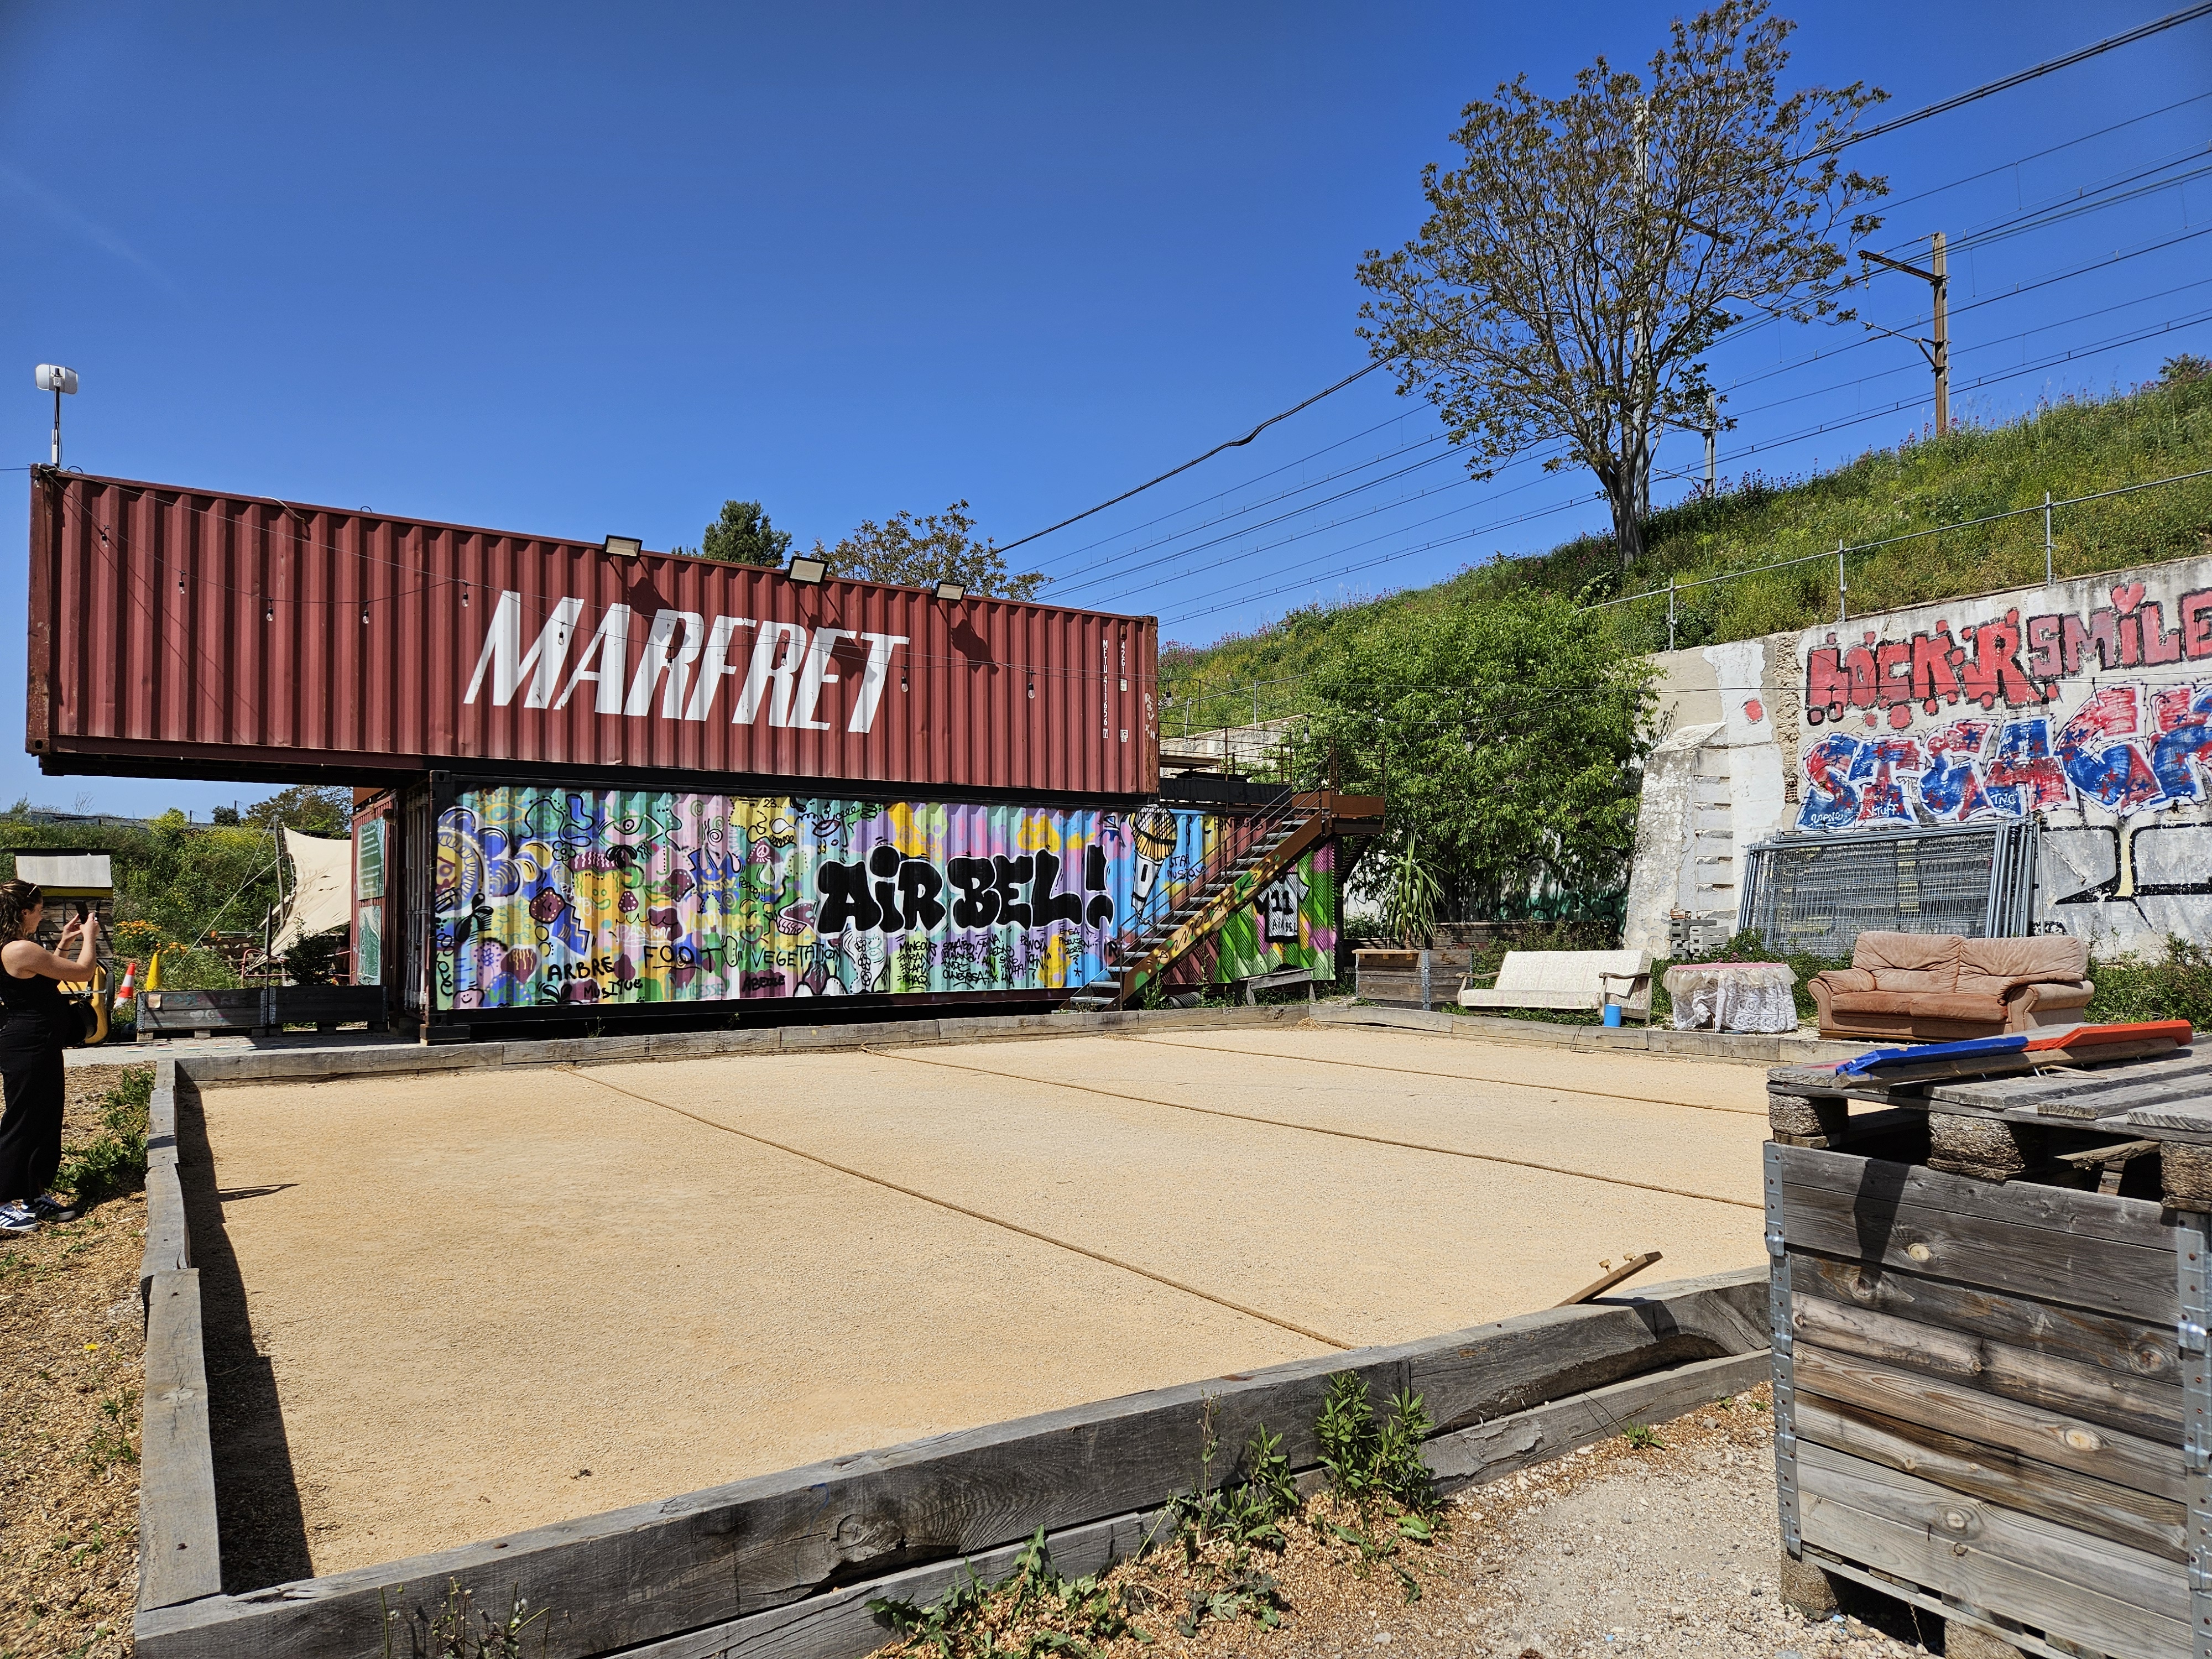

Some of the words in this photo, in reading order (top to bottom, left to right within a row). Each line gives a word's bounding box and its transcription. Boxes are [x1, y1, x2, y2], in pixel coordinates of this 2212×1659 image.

[464, 590, 910, 734] MARFRET
[1271, 890, 1294, 915] 11
[547, 956, 615, 981] ARBRE
[644, 945, 721, 973] FOOT
